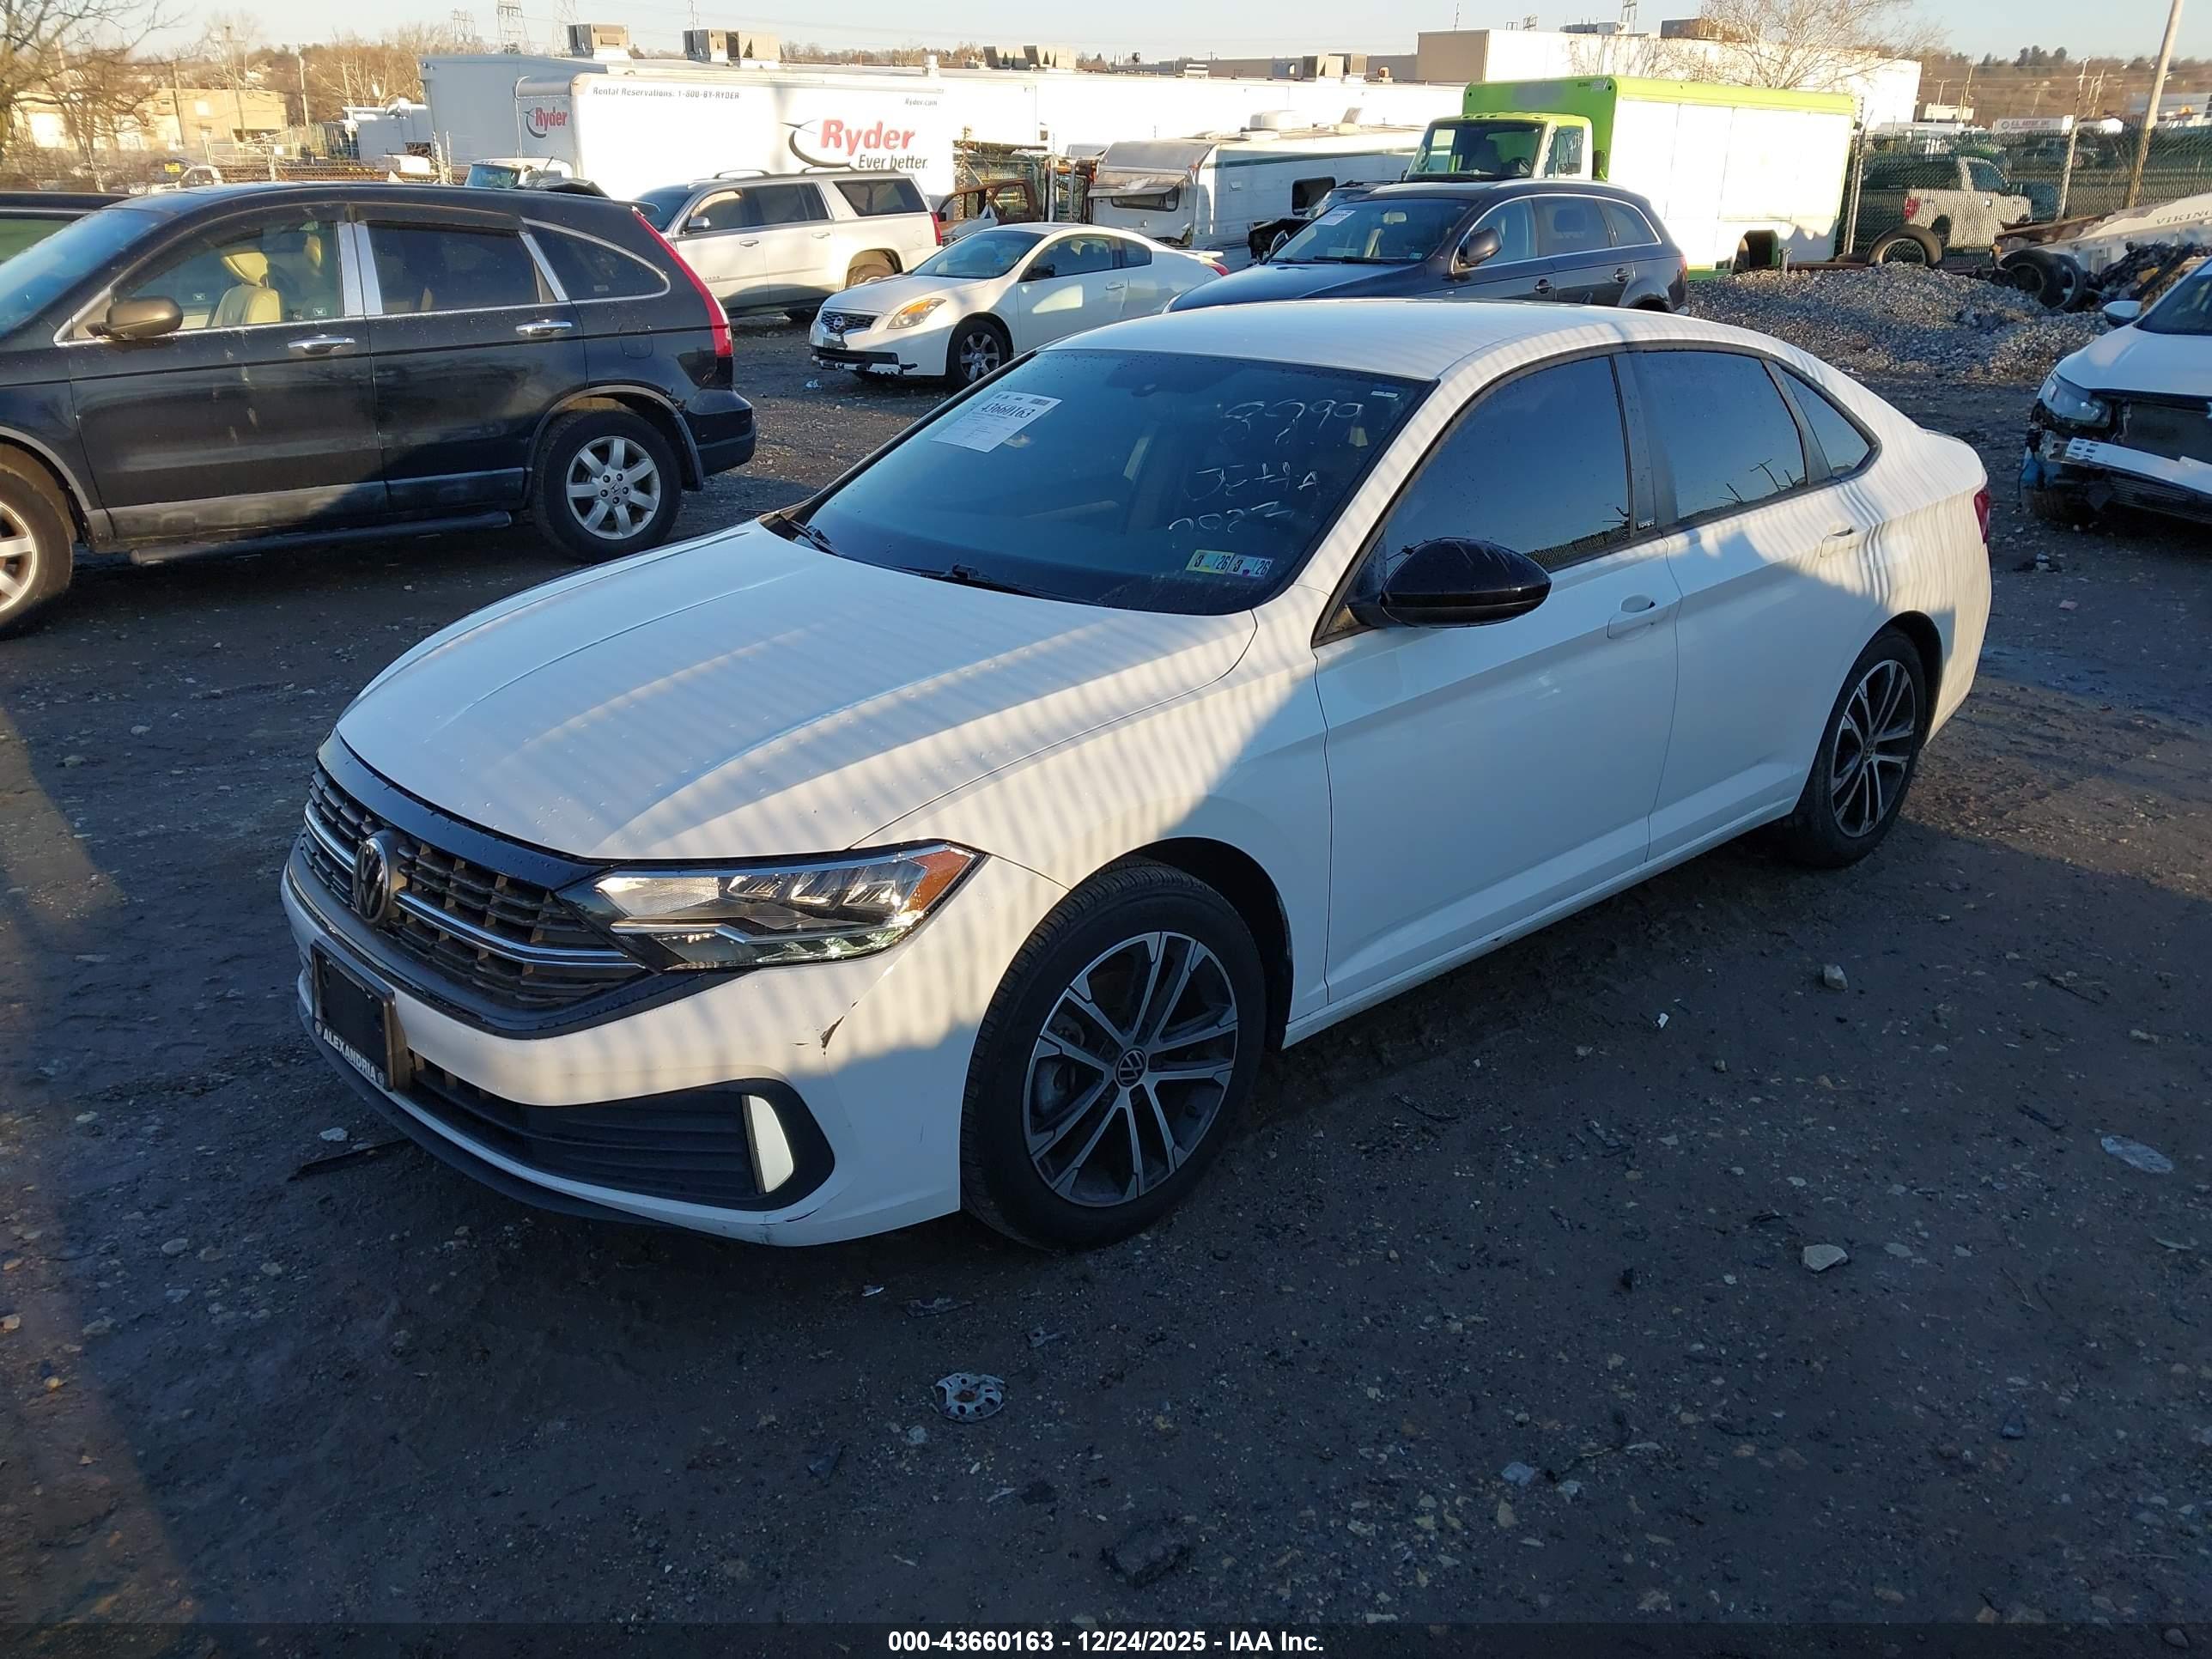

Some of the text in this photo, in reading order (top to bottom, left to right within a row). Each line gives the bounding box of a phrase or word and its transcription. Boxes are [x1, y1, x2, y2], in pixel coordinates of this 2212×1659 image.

[593, 87, 740, 100] Rental Reservations: 1-800-BY-RYDER
[904, 97, 938, 107] Ryder.com
[535, 106, 568, 131] Ryder
[821, 119, 916, 156] Ryder
[859, 155, 888, 169] Ever
[980, 401, 1036, 419] 43660163
[1194, 554, 1232, 572] 3 26
[1232, 558, 1272, 576] 3 26
[322, 1027, 377, 1082] ALEXANDRIA
